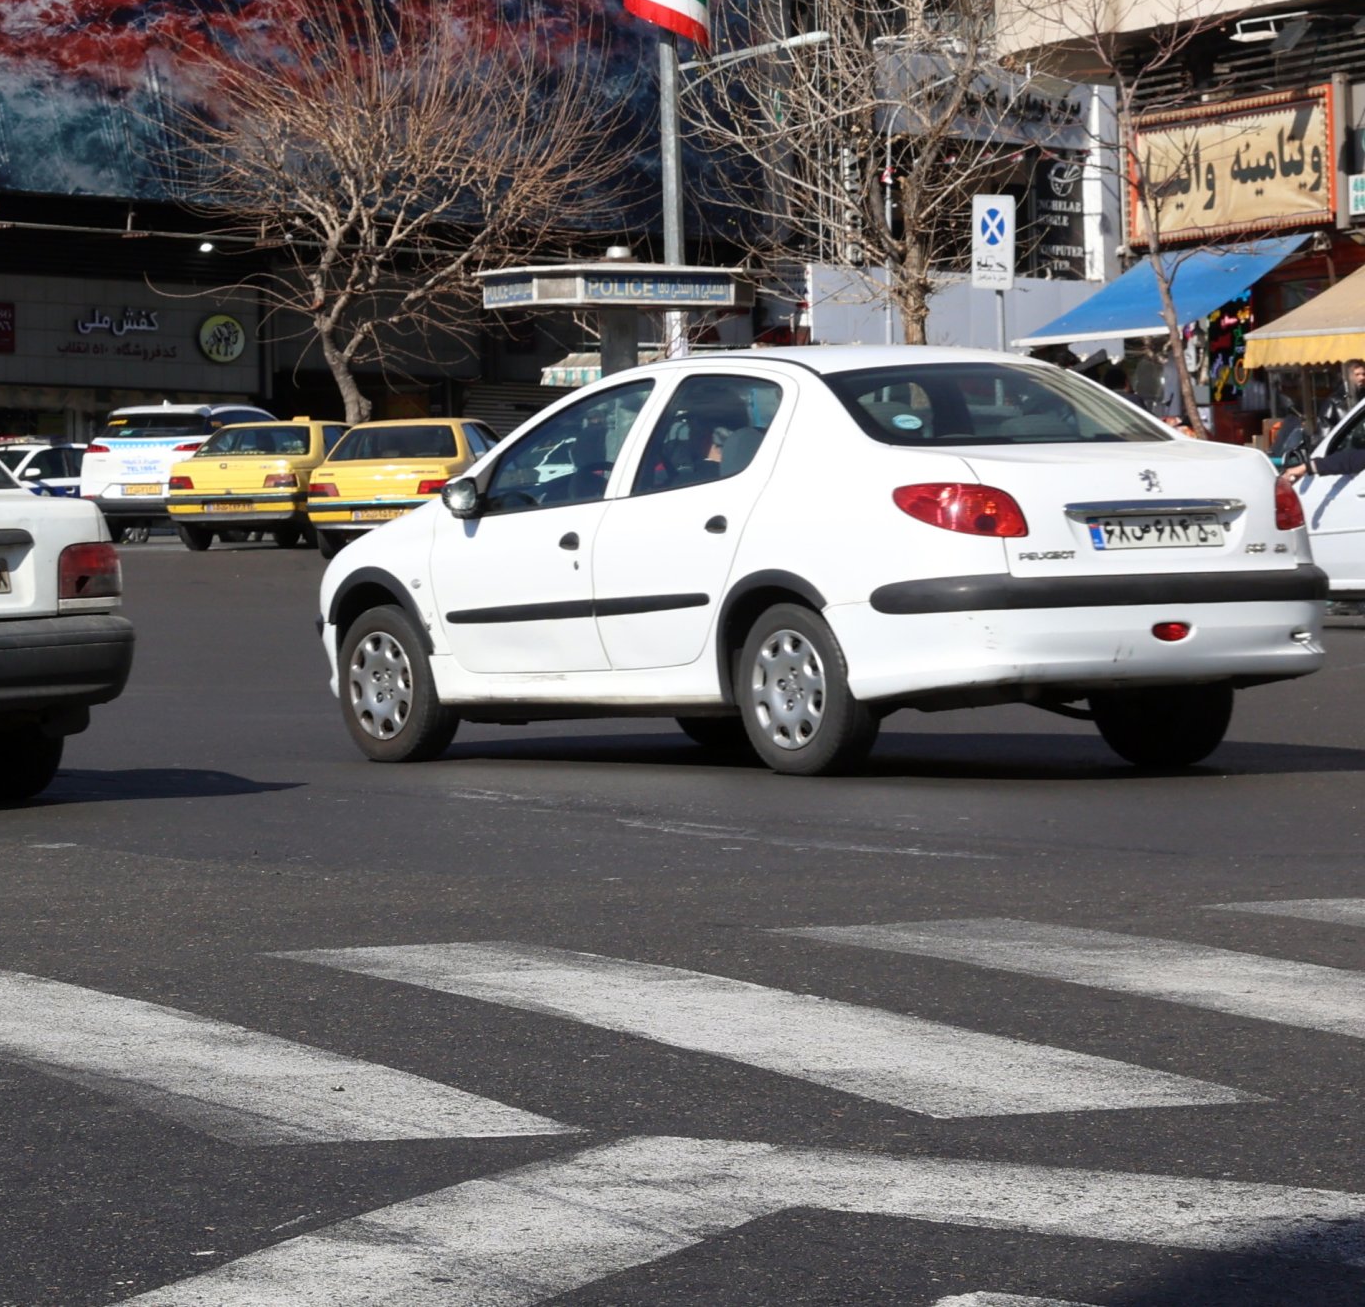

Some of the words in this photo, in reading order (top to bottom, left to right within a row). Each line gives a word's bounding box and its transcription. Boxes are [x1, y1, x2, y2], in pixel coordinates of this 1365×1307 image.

[587, 277, 654, 297] POLICE
[77, 308, 111, 334] ملی
[112, 307, 159, 335] کفش
[1018, 550, 1076, 561] PEUGEOT
